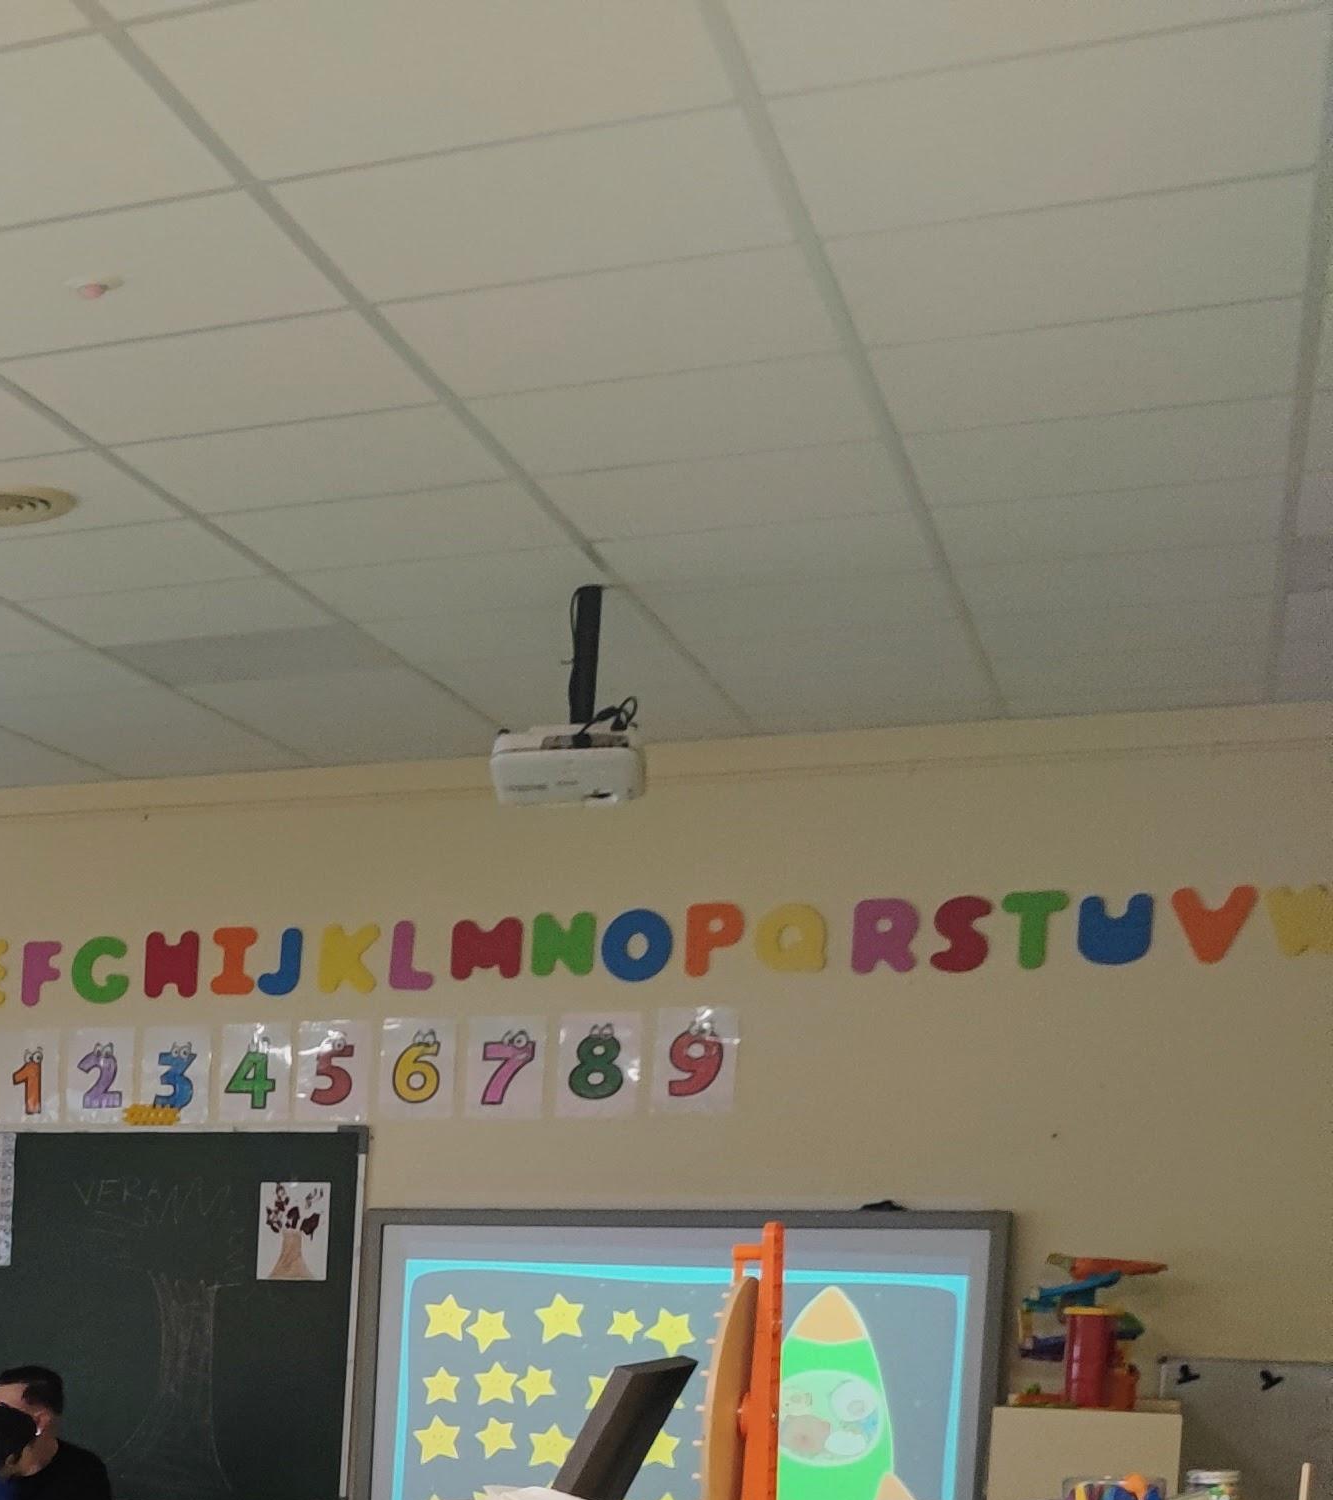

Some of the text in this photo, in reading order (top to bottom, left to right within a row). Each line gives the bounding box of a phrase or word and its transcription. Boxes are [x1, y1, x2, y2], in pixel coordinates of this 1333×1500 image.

[12, 1060, 42, 1115] 1
[77, 1052, 123, 1109] 2
[153, 1051, 197, 1111] 3
[225, 1050, 277, 1109] 4
[310, 1043, 355, 1106] 5
[392, 1040, 441, 1104] 6
[481, 1041, 536, 1105] 7
[568, 1033, 623, 1099] 8
[667, 1029, 724, 1097] 9
